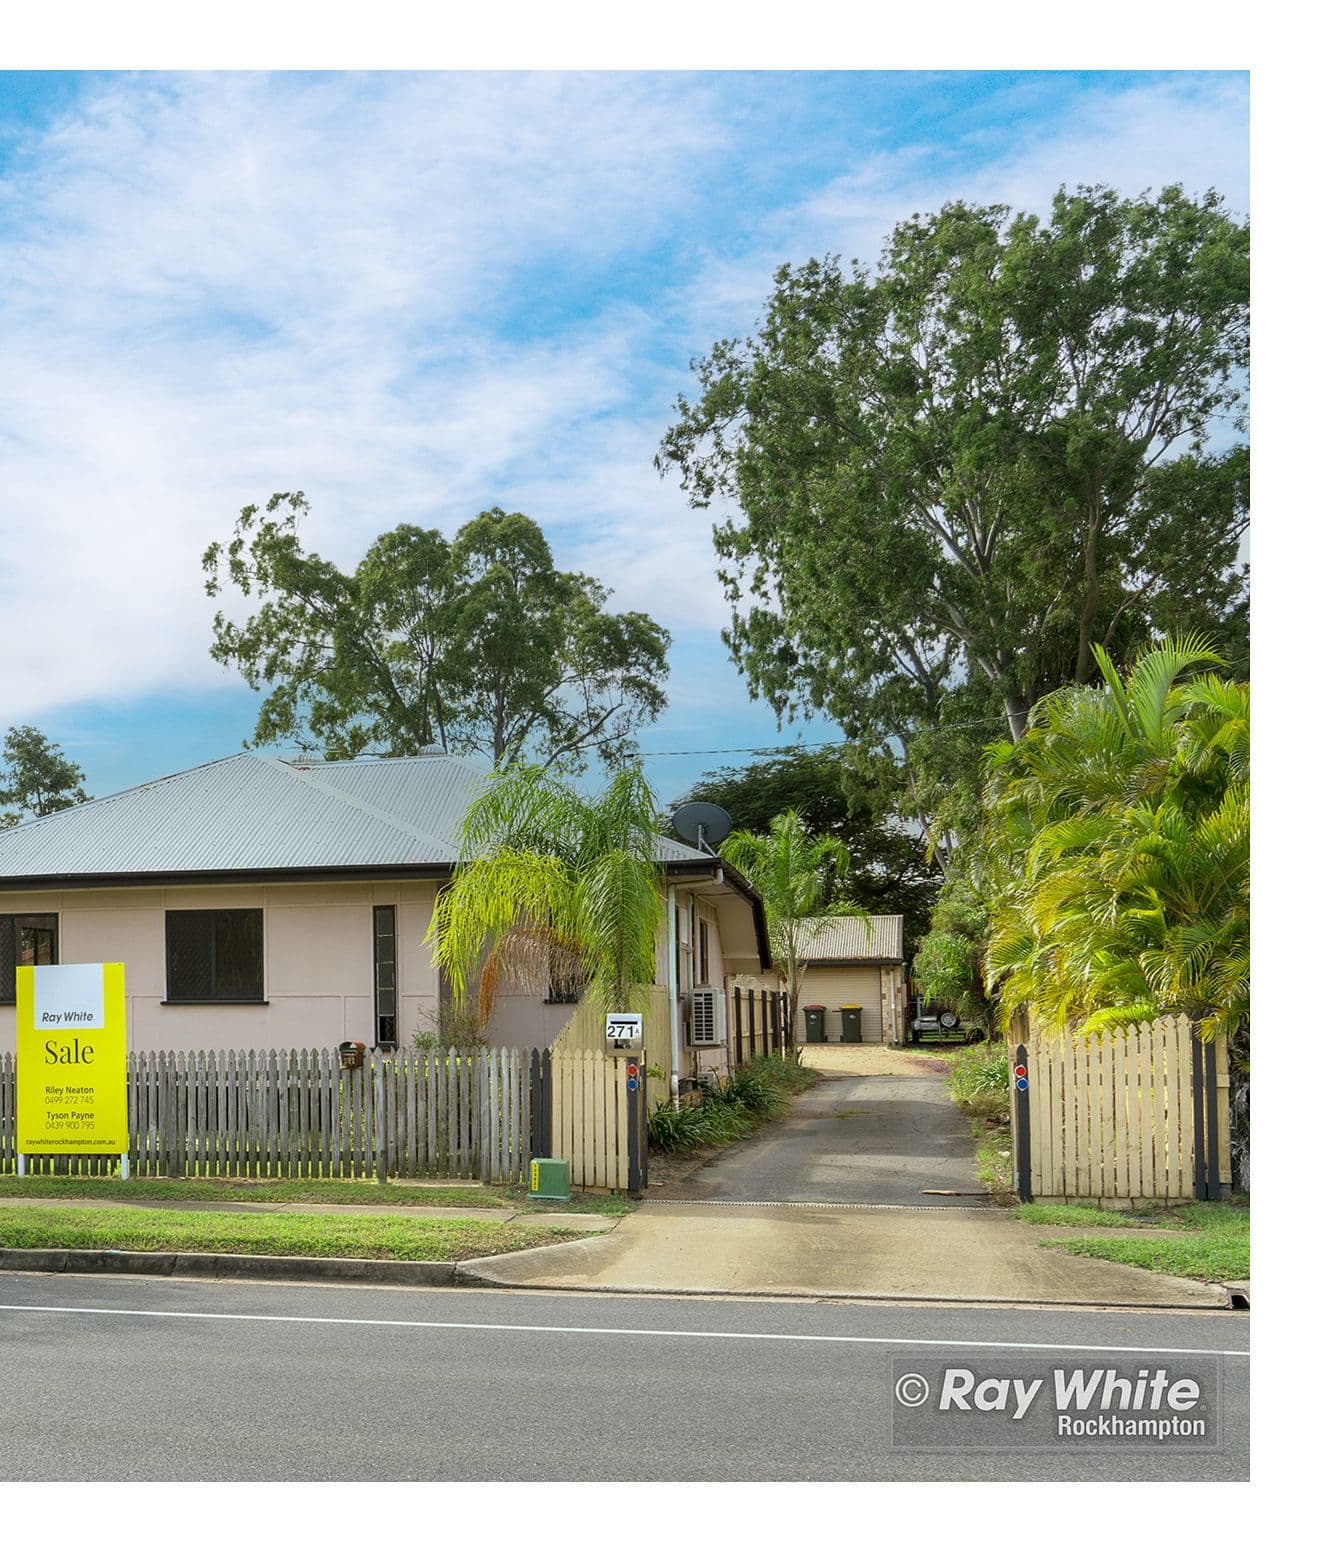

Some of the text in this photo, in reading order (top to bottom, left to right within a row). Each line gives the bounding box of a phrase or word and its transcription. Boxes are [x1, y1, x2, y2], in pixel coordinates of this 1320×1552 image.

[42, 1011, 94, 1024] Ray White
[45, 1038, 95, 1064] Sale
[45, 1086, 95, 1095] Riley Neaton
[46, 1111, 95, 1120] Tyson Payne
[25, 1138, 116, 1146] raywhiterockhampton.com.au
